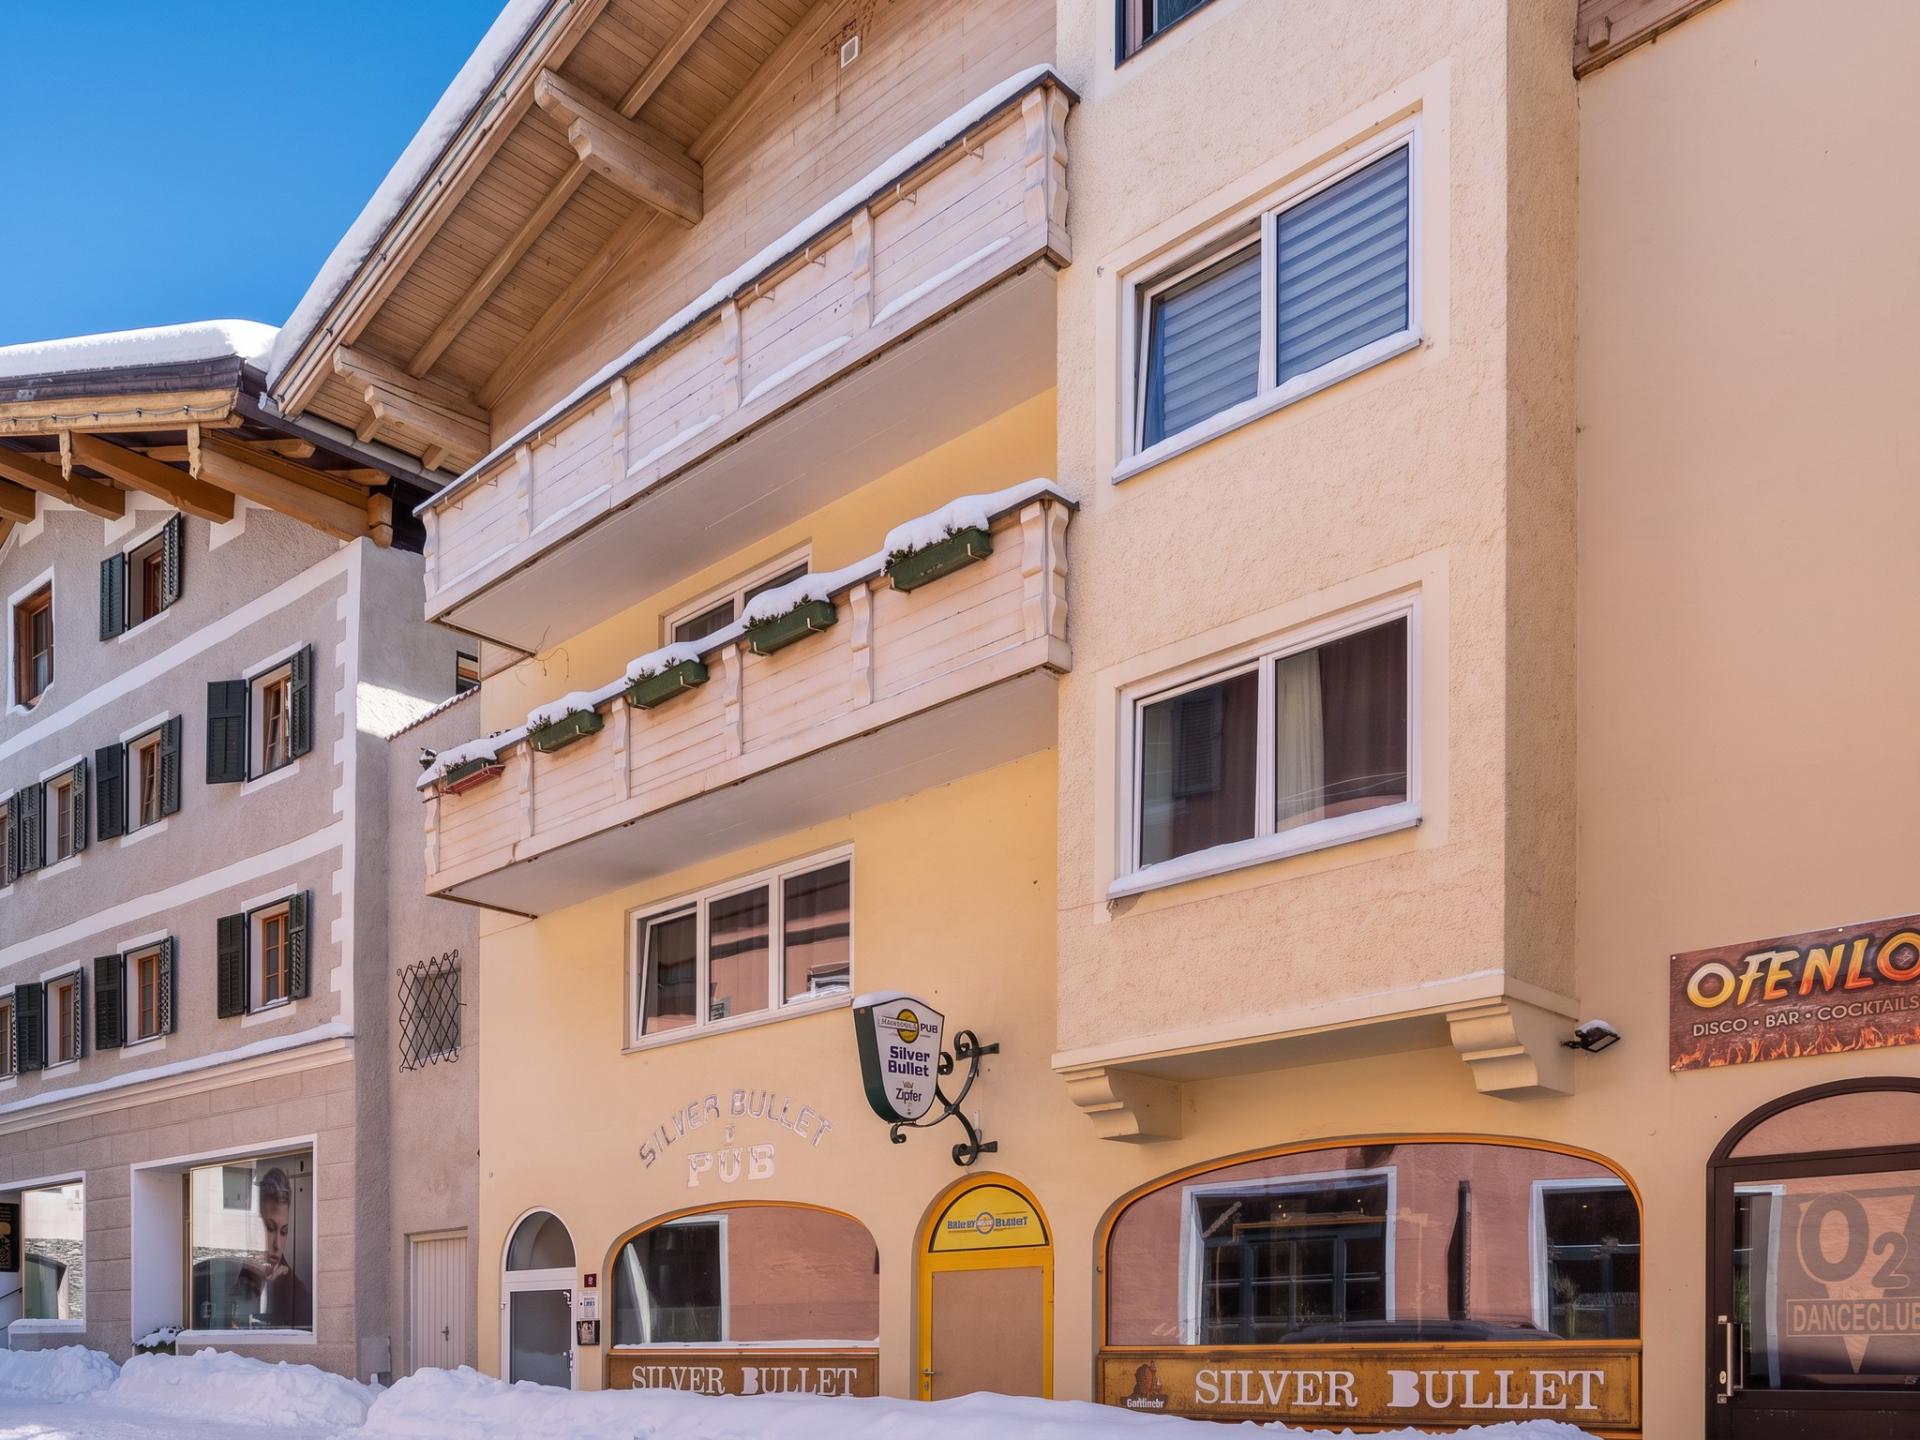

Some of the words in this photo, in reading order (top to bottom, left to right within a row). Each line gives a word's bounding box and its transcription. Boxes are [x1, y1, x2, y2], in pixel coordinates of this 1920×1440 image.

[920, 1023, 938, 1034] PUB
[1693, 1018, 1748, 1037] DISCO
[1765, 1011, 1799, 1028] BAR
[1817, 996, 1920, 1021] COCKTAILS
[888, 1060, 930, 1077] Bullet
[890, 1046, 930, 1063] Silver
[896, 1088, 922, 1104] Zipfer
[639, 1094, 721, 1168] SILVER
[730, 1088, 833, 1148] BULLET
[687, 1143, 776, 1188] PUB
[631, 1365, 726, 1394] SILVER
[740, 1367, 858, 1396] BULLET
[1195, 1369, 1358, 1408] SILVER
[1387, 1370, 1604, 1410] BULLET
